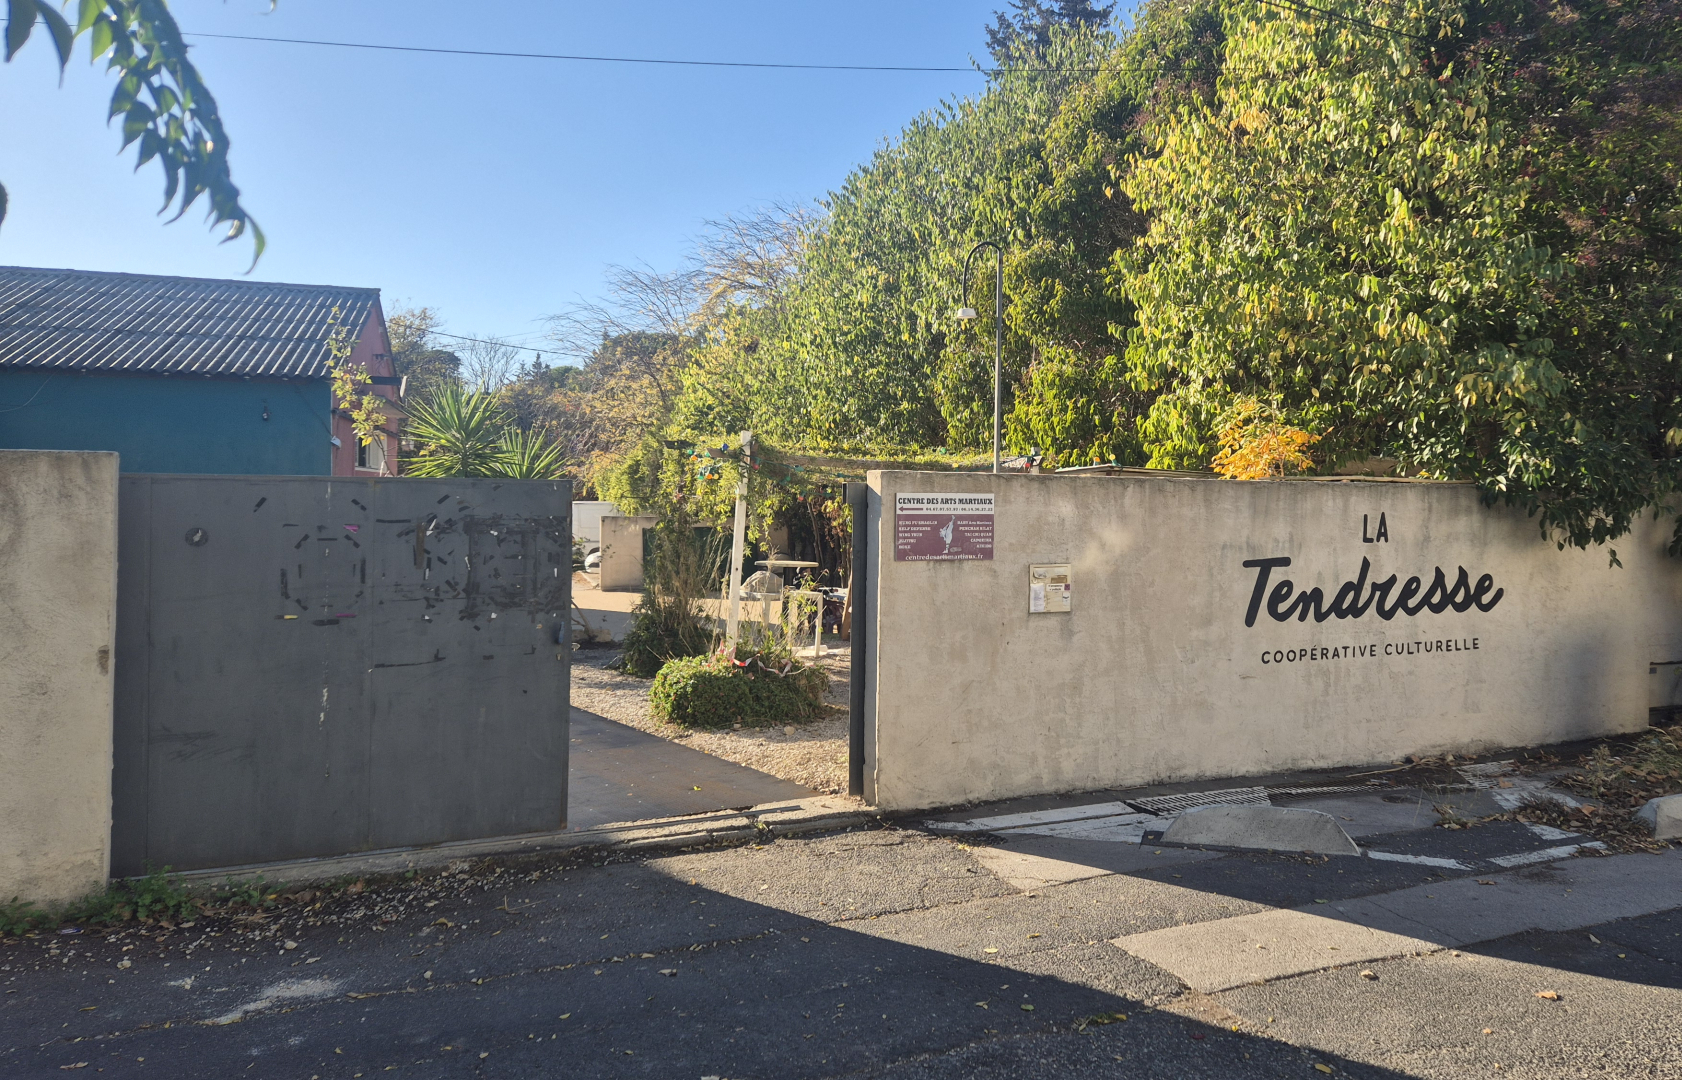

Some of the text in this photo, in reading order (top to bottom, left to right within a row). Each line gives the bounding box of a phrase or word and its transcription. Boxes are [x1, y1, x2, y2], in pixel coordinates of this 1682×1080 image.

[1362, 512, 1388, 543] LA
[905, 553, 984, 561] centredesartsmartiaux.fr
[1242, 556, 1504, 628] Tendresse
[1261, 638, 1480, 664] COOPÉRATIVE CULTURELLE
